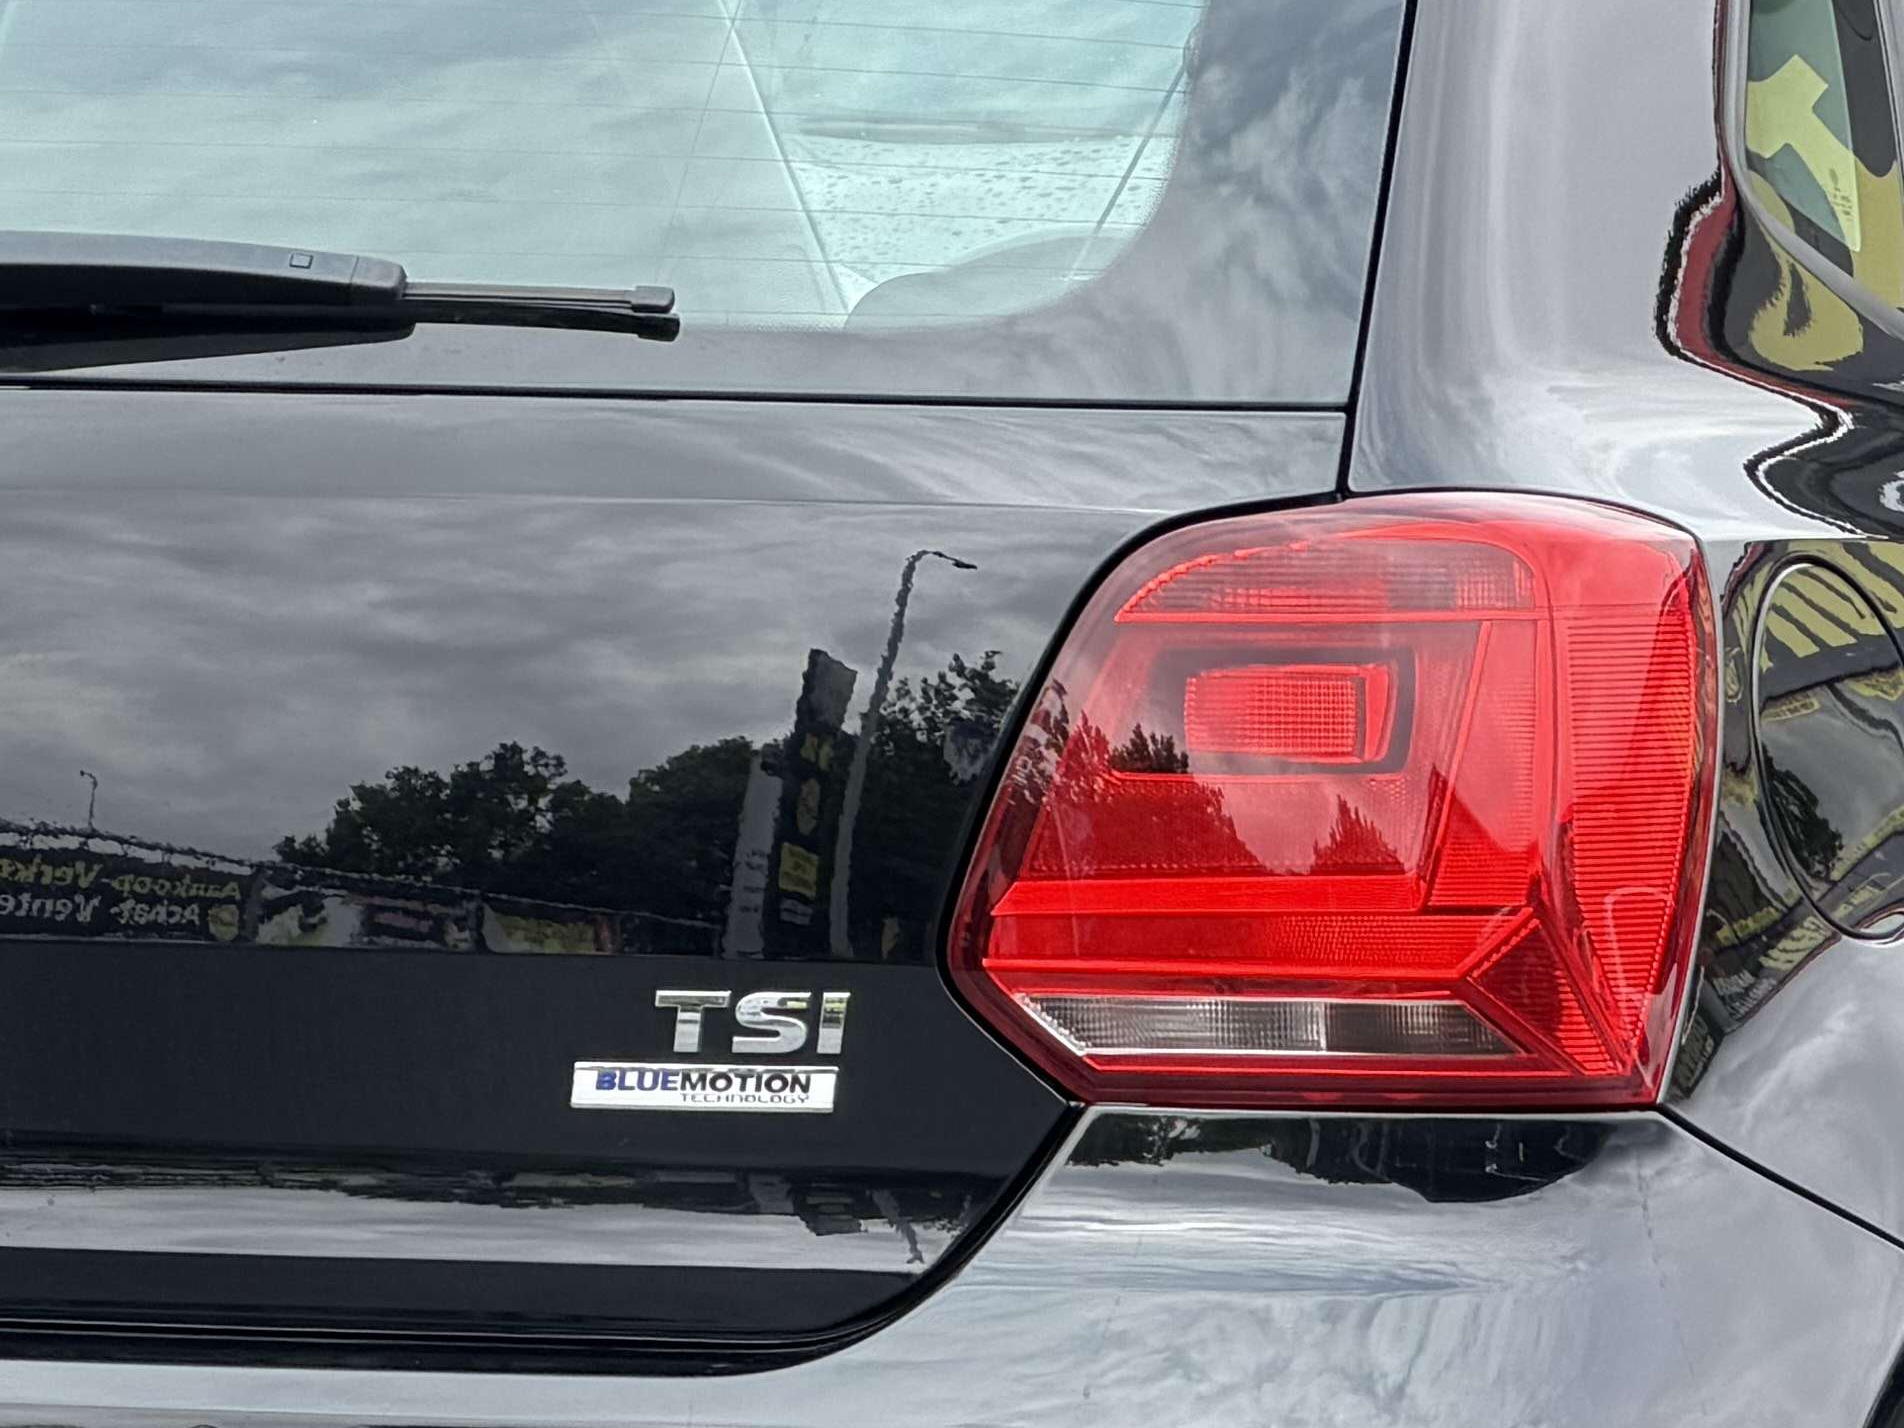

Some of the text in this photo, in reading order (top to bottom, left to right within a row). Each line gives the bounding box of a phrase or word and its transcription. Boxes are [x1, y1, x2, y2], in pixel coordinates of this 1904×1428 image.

[654, 989, 851, 1054] TSI
[595, 1067, 812, 1094] BLUEMOTION
[680, 1091, 810, 1104] TECHNOLOGY
